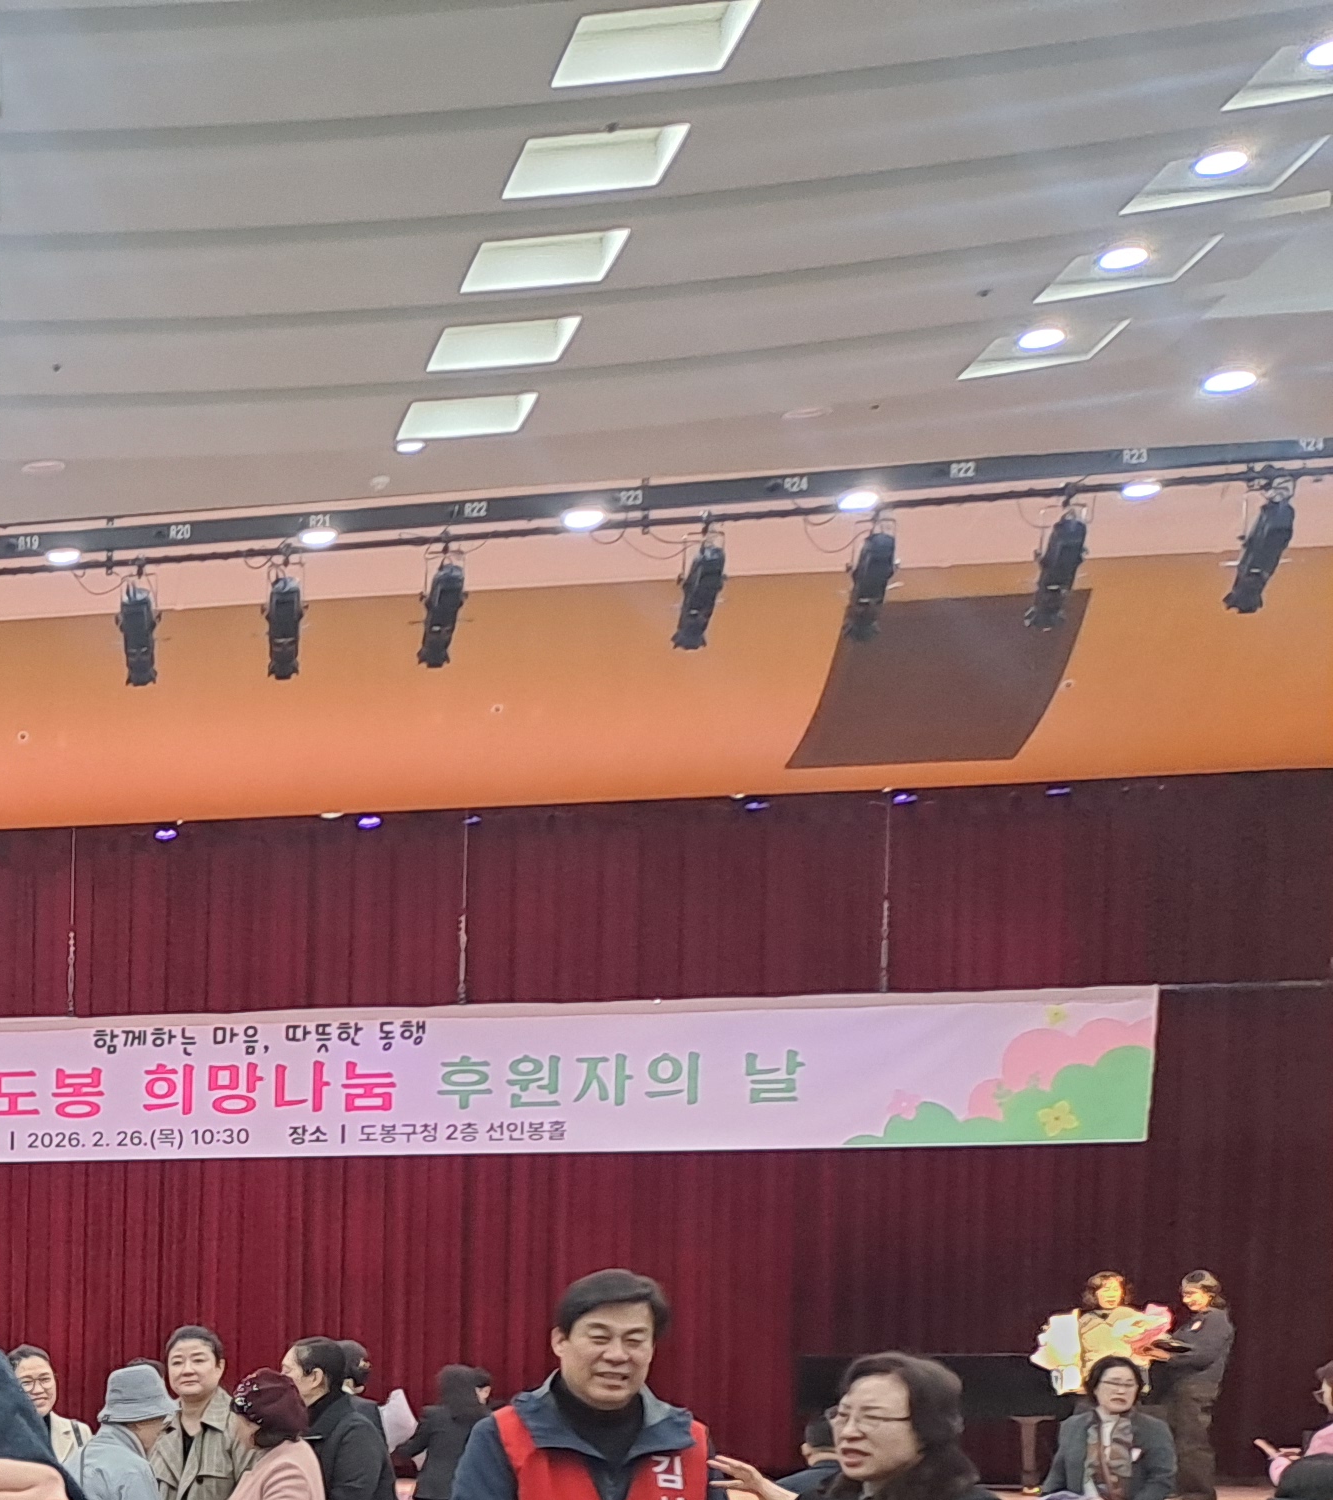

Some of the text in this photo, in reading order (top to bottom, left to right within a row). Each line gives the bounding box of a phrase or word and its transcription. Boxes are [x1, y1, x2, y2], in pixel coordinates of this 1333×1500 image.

[1122, 448, 1148, 464] R23
[950, 462, 976, 478] R22
[784, 477, 809, 492] R24
[620, 489, 643, 505] R23
[464, 501, 487, 517] R22
[309, 515, 330, 528] R21
[169, 524, 191, 539] R20
[17, 535, 39, 550] R19
[92, 1020, 427, 1056] 함께하는 마음, 따뜻한 동행
[142, 1060, 397, 1115] 희망나눔
[436, 1051, 700, 1110] 후원자의
[745, 1049, 806, 1105] 날
[27, 1131, 85, 1149] 2026.
[92, 1131, 109, 1147] 2.
[116, 1128, 184, 1150] 26.(목)
[191, 1128, 250, 1145] 10:30
[288, 1124, 328, 1145] 장소
[358, 1122, 438, 1143] 도봉구청
[445, 1122, 479, 1142] 2층
[486, 1120, 567, 1142] 선인봉홀
